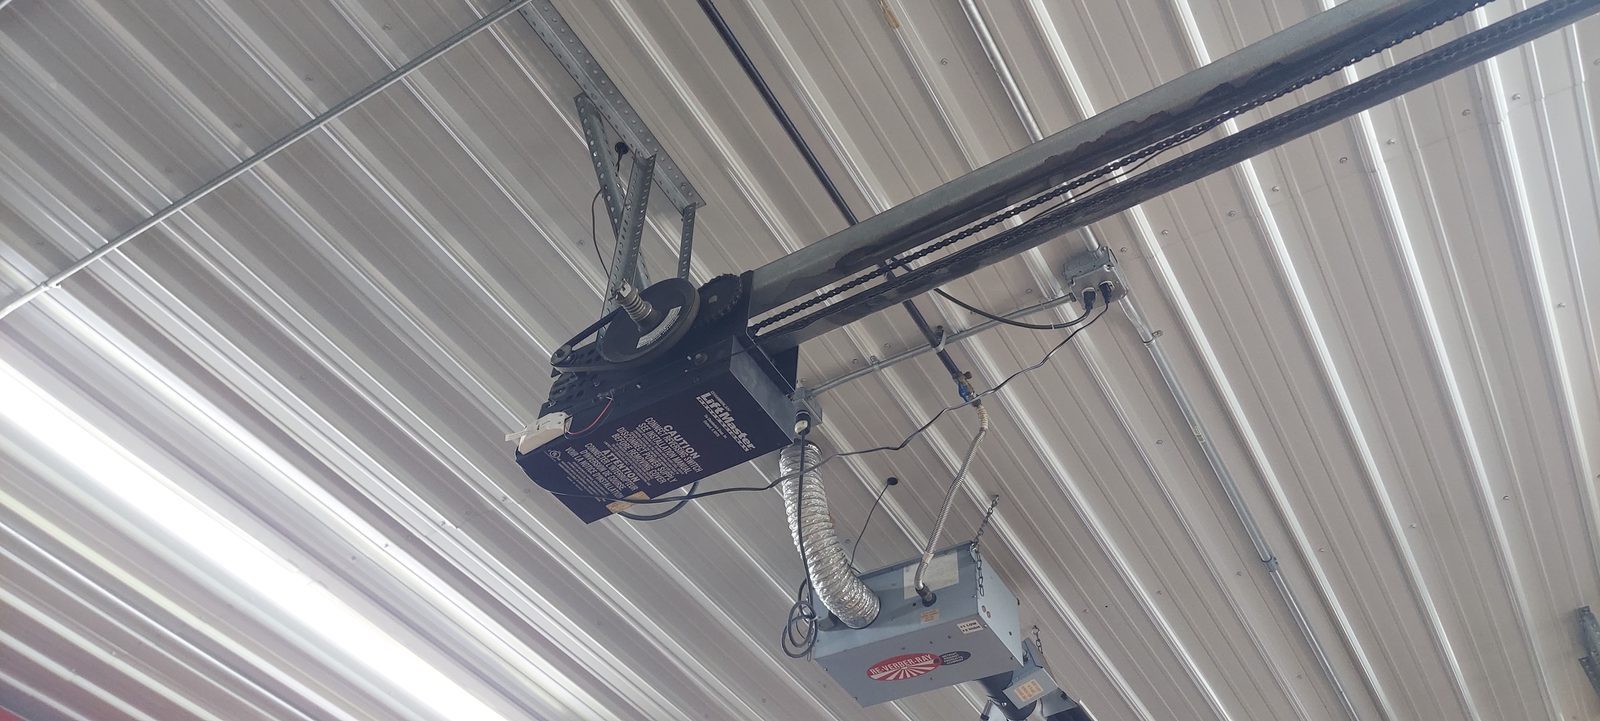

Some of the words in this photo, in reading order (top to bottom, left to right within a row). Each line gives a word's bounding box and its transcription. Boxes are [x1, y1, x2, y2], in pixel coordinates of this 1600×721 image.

[644, 416, 668, 437] CONNECT
[662, 434, 688, 458] REVERSING
[683, 455, 703, 473] SWITCH
[662, 423, 700, 459] CAUTION
[699, 391, 756, 450] LiftMaster
[574, 455, 584, 463] LA
[579, 460, 598, 476] NOTICE
[601, 449, 640, 483] ATTENTION
[611, 432, 632, 451] BEFORE
[627, 448, 653, 472] REMOVING
[648, 469, 666, 484] COVER
[616, 426, 647, 454] DISCONNECT
[642, 451, 662, 469] POWER
[656, 466, 677, 484] SUPPLY
[637, 421, 650, 433] SEE
[645, 429, 677, 459] INSTALLATION
[672, 456, 692, 474] MANUAL
